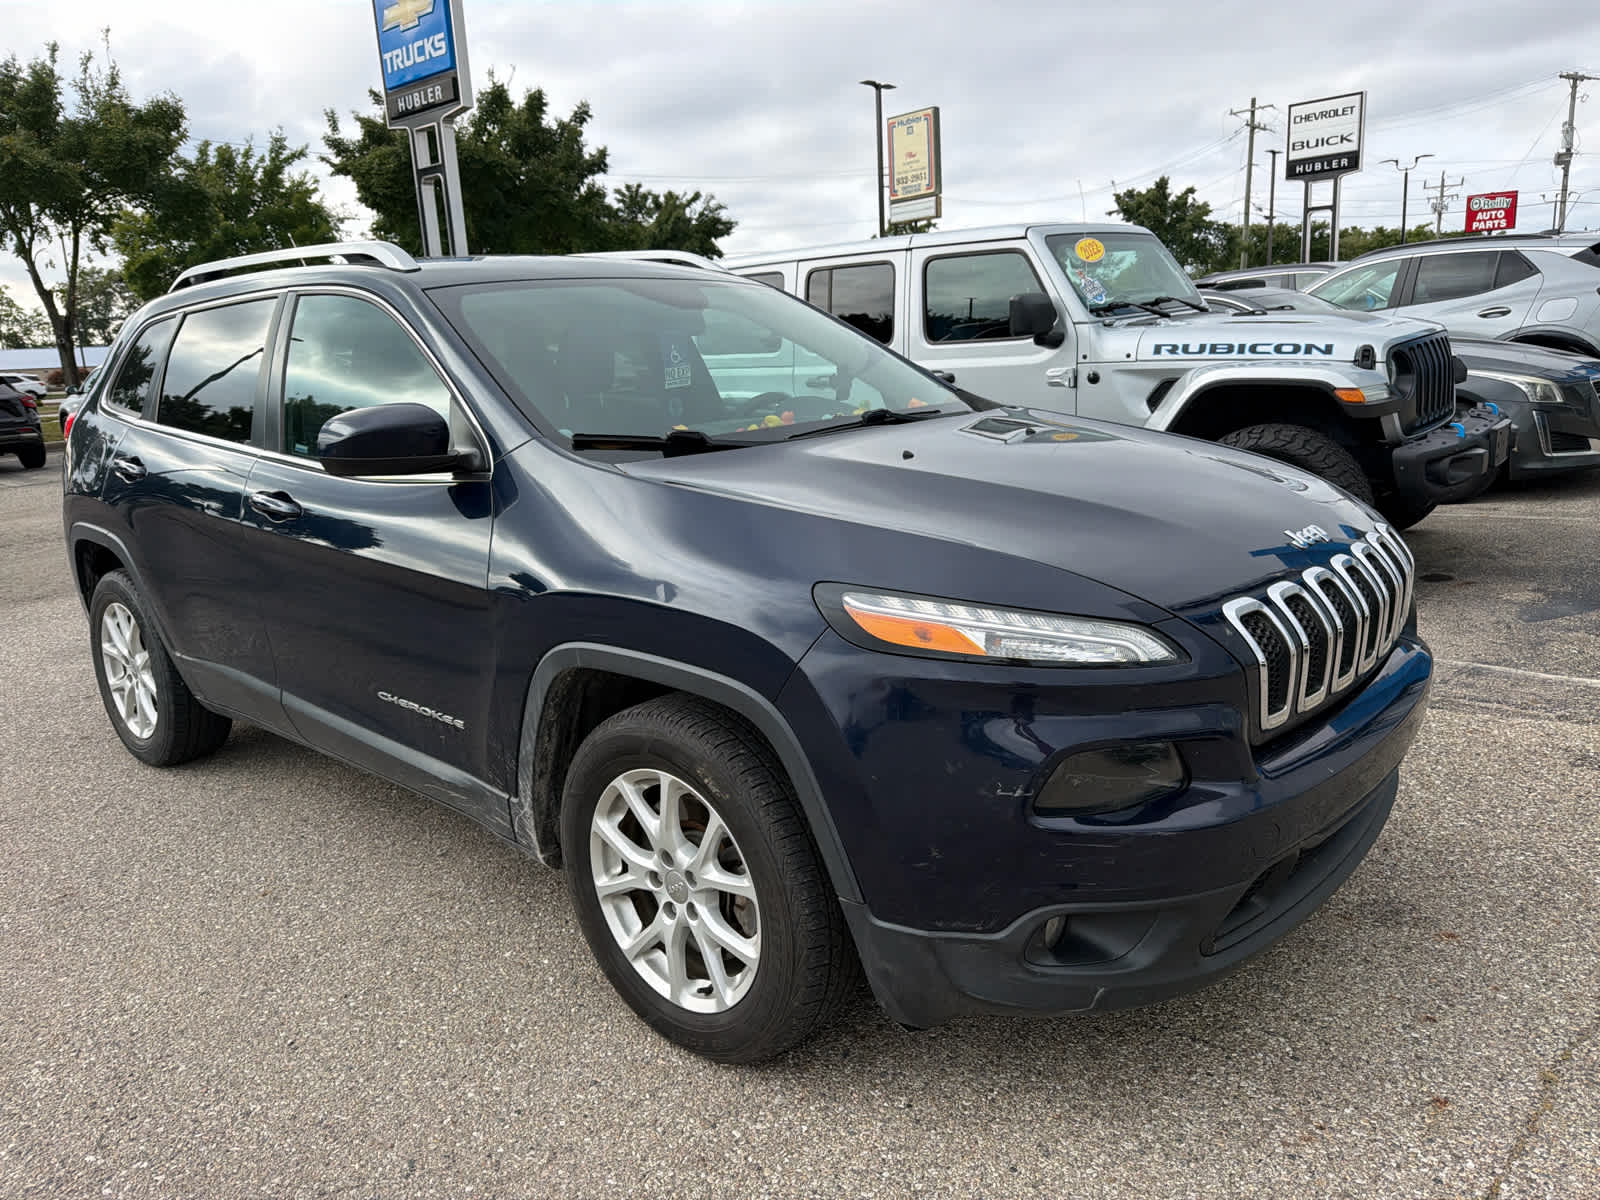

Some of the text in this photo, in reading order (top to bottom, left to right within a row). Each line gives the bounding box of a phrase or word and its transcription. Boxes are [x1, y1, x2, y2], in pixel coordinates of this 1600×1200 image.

[383, 32, 447, 74] TRUCKS
[397, 85, 443, 112] HUBLER
[1293, 105, 1356, 125] CHEVROLET
[1291, 132, 1354, 152] BUICK
[1295, 157, 1349, 174] HUBLER
[1472, 219, 1507, 230] PARTS
[1476, 210, 1505, 220] AUTO
[1153, 343, 1335, 356] RUBICON
[1283, 524, 1329, 550] Jeep
[377, 691, 465, 730] CHEROKEE
